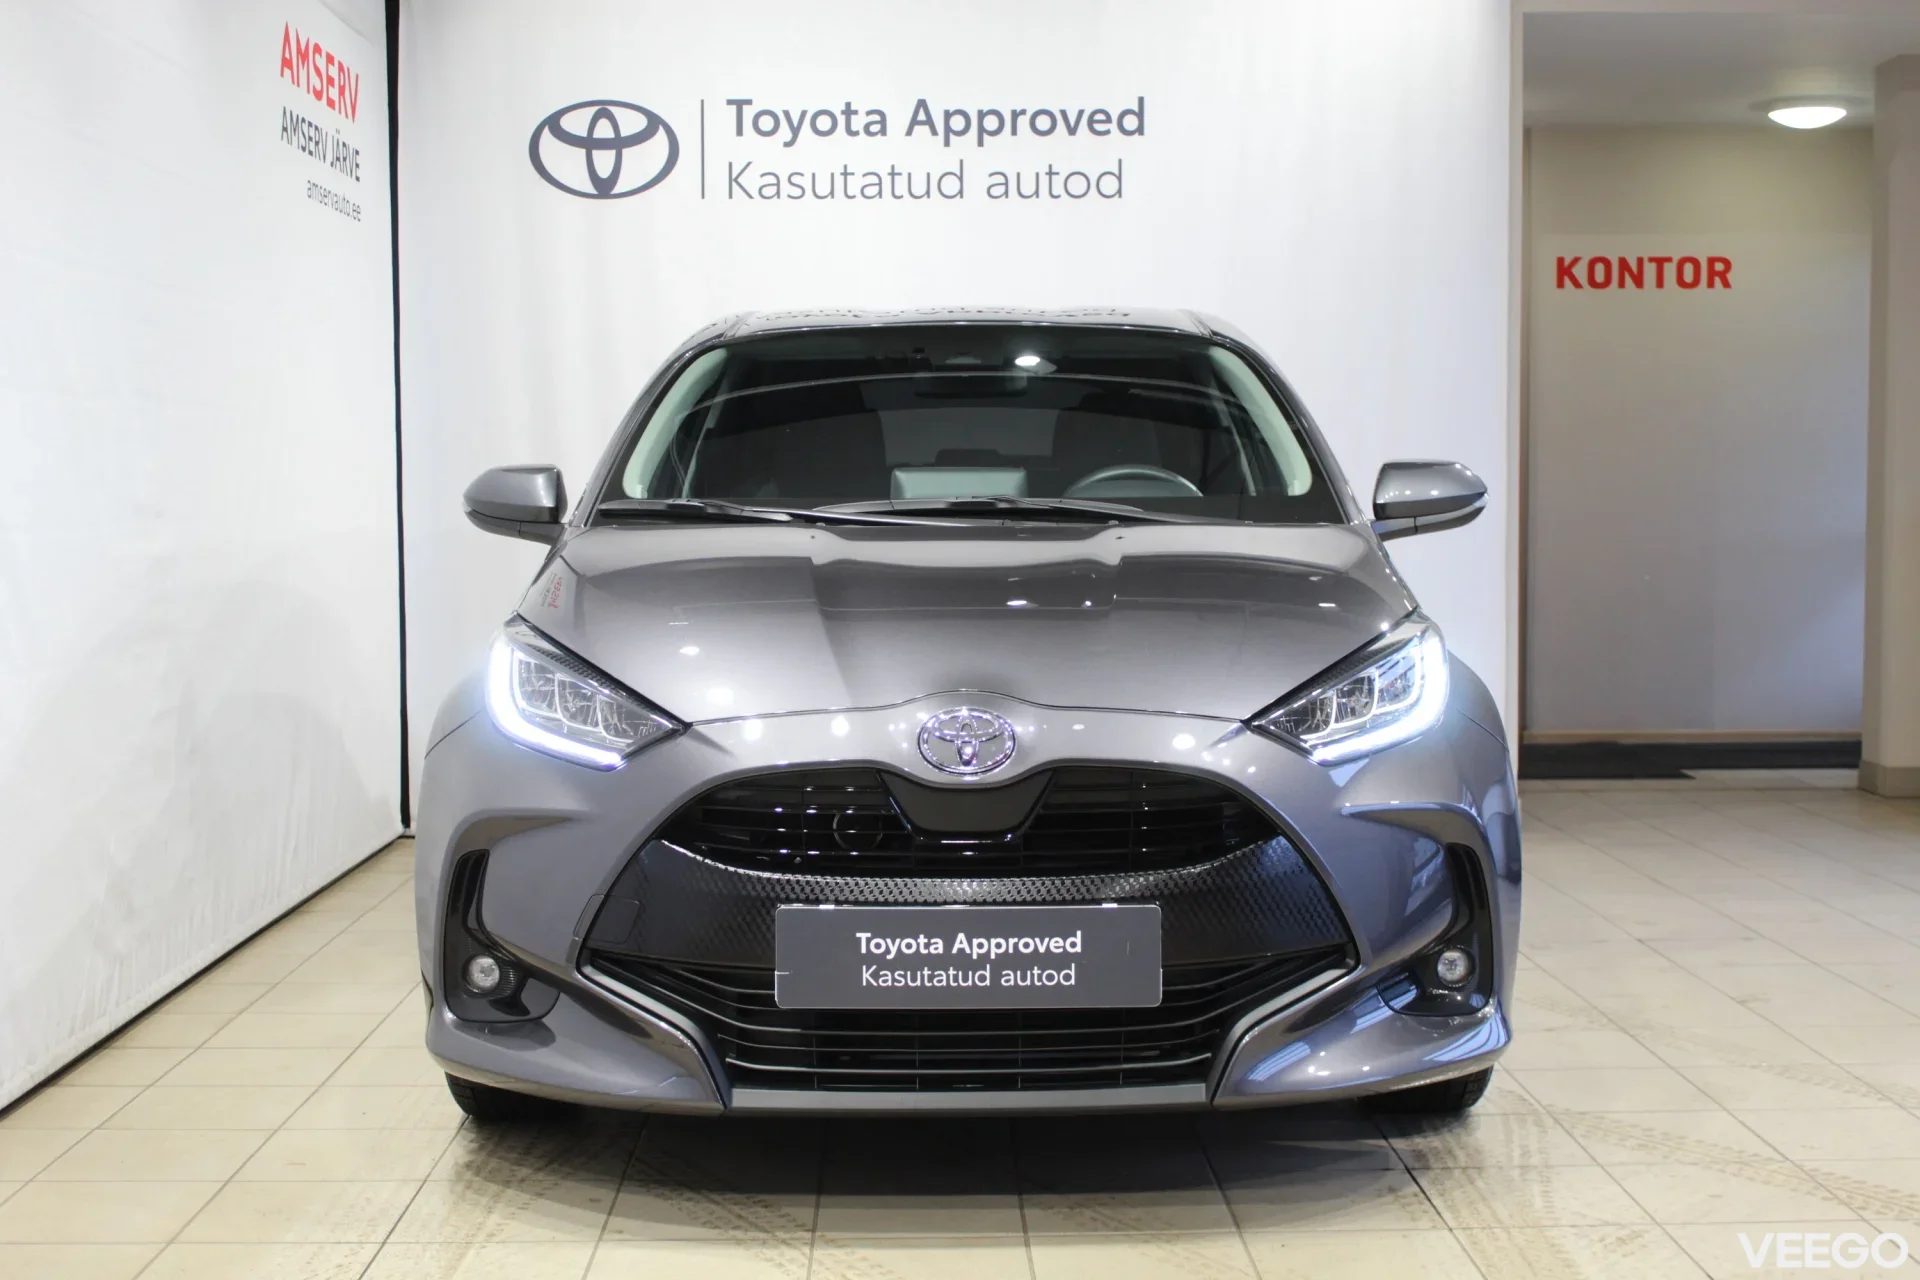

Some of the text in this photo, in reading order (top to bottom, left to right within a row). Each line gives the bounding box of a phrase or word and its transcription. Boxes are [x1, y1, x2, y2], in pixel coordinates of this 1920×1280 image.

[280, 20, 359, 124] AMSERV
[726, 96, 1145, 148] Toyota Approved
[281, 106, 361, 183] AMSERV JÄRVE
[306, 179, 362, 222] amservauto.ee
[727, 159, 1123, 200] Kasutatud autod
[1556, 256, 1732, 290] KONTOR
[855, 930, 1082, 959] Toyota Approved
[861, 963, 1076, 987] Kasutatud autod
